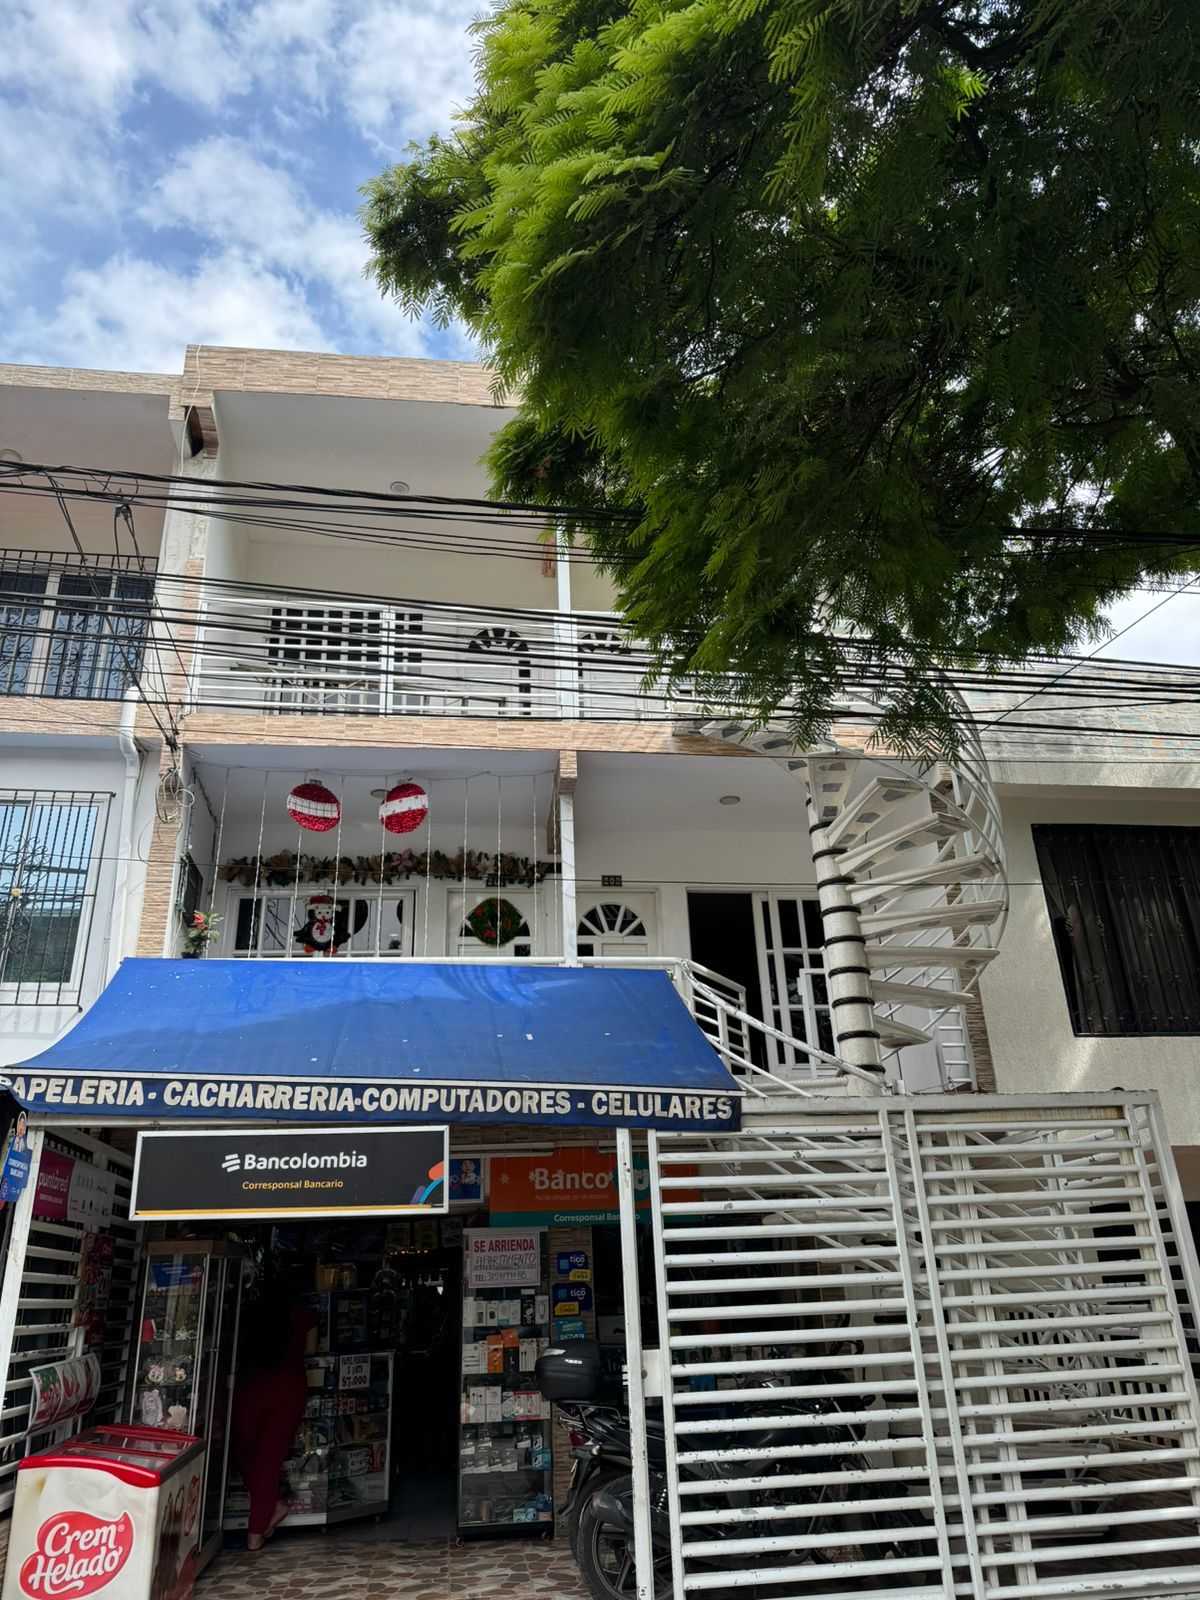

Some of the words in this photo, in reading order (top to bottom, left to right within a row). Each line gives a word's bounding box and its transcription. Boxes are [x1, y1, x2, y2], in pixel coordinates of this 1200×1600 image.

[603, 876, 621, 886] 202
[591, 1092, 733, 1120] CELULARES
[243, 1150, 368, 1170] Bancolombia
[242, 1180, 303, 1191] Corresponsal
[303, 1178, 344, 1189] Bancario
[534, 1167, 610, 1191] Banco
[554, 1213, 605, 1223] Corresponsal
[606, 1213, 640, 1221] Bano
[473, 1240, 486, 1253] SE
[488, 1239, 535, 1253] ARRIENDA
[44, 1522, 117, 1557] Crem
[28, 1546, 123, 1595] Helado
